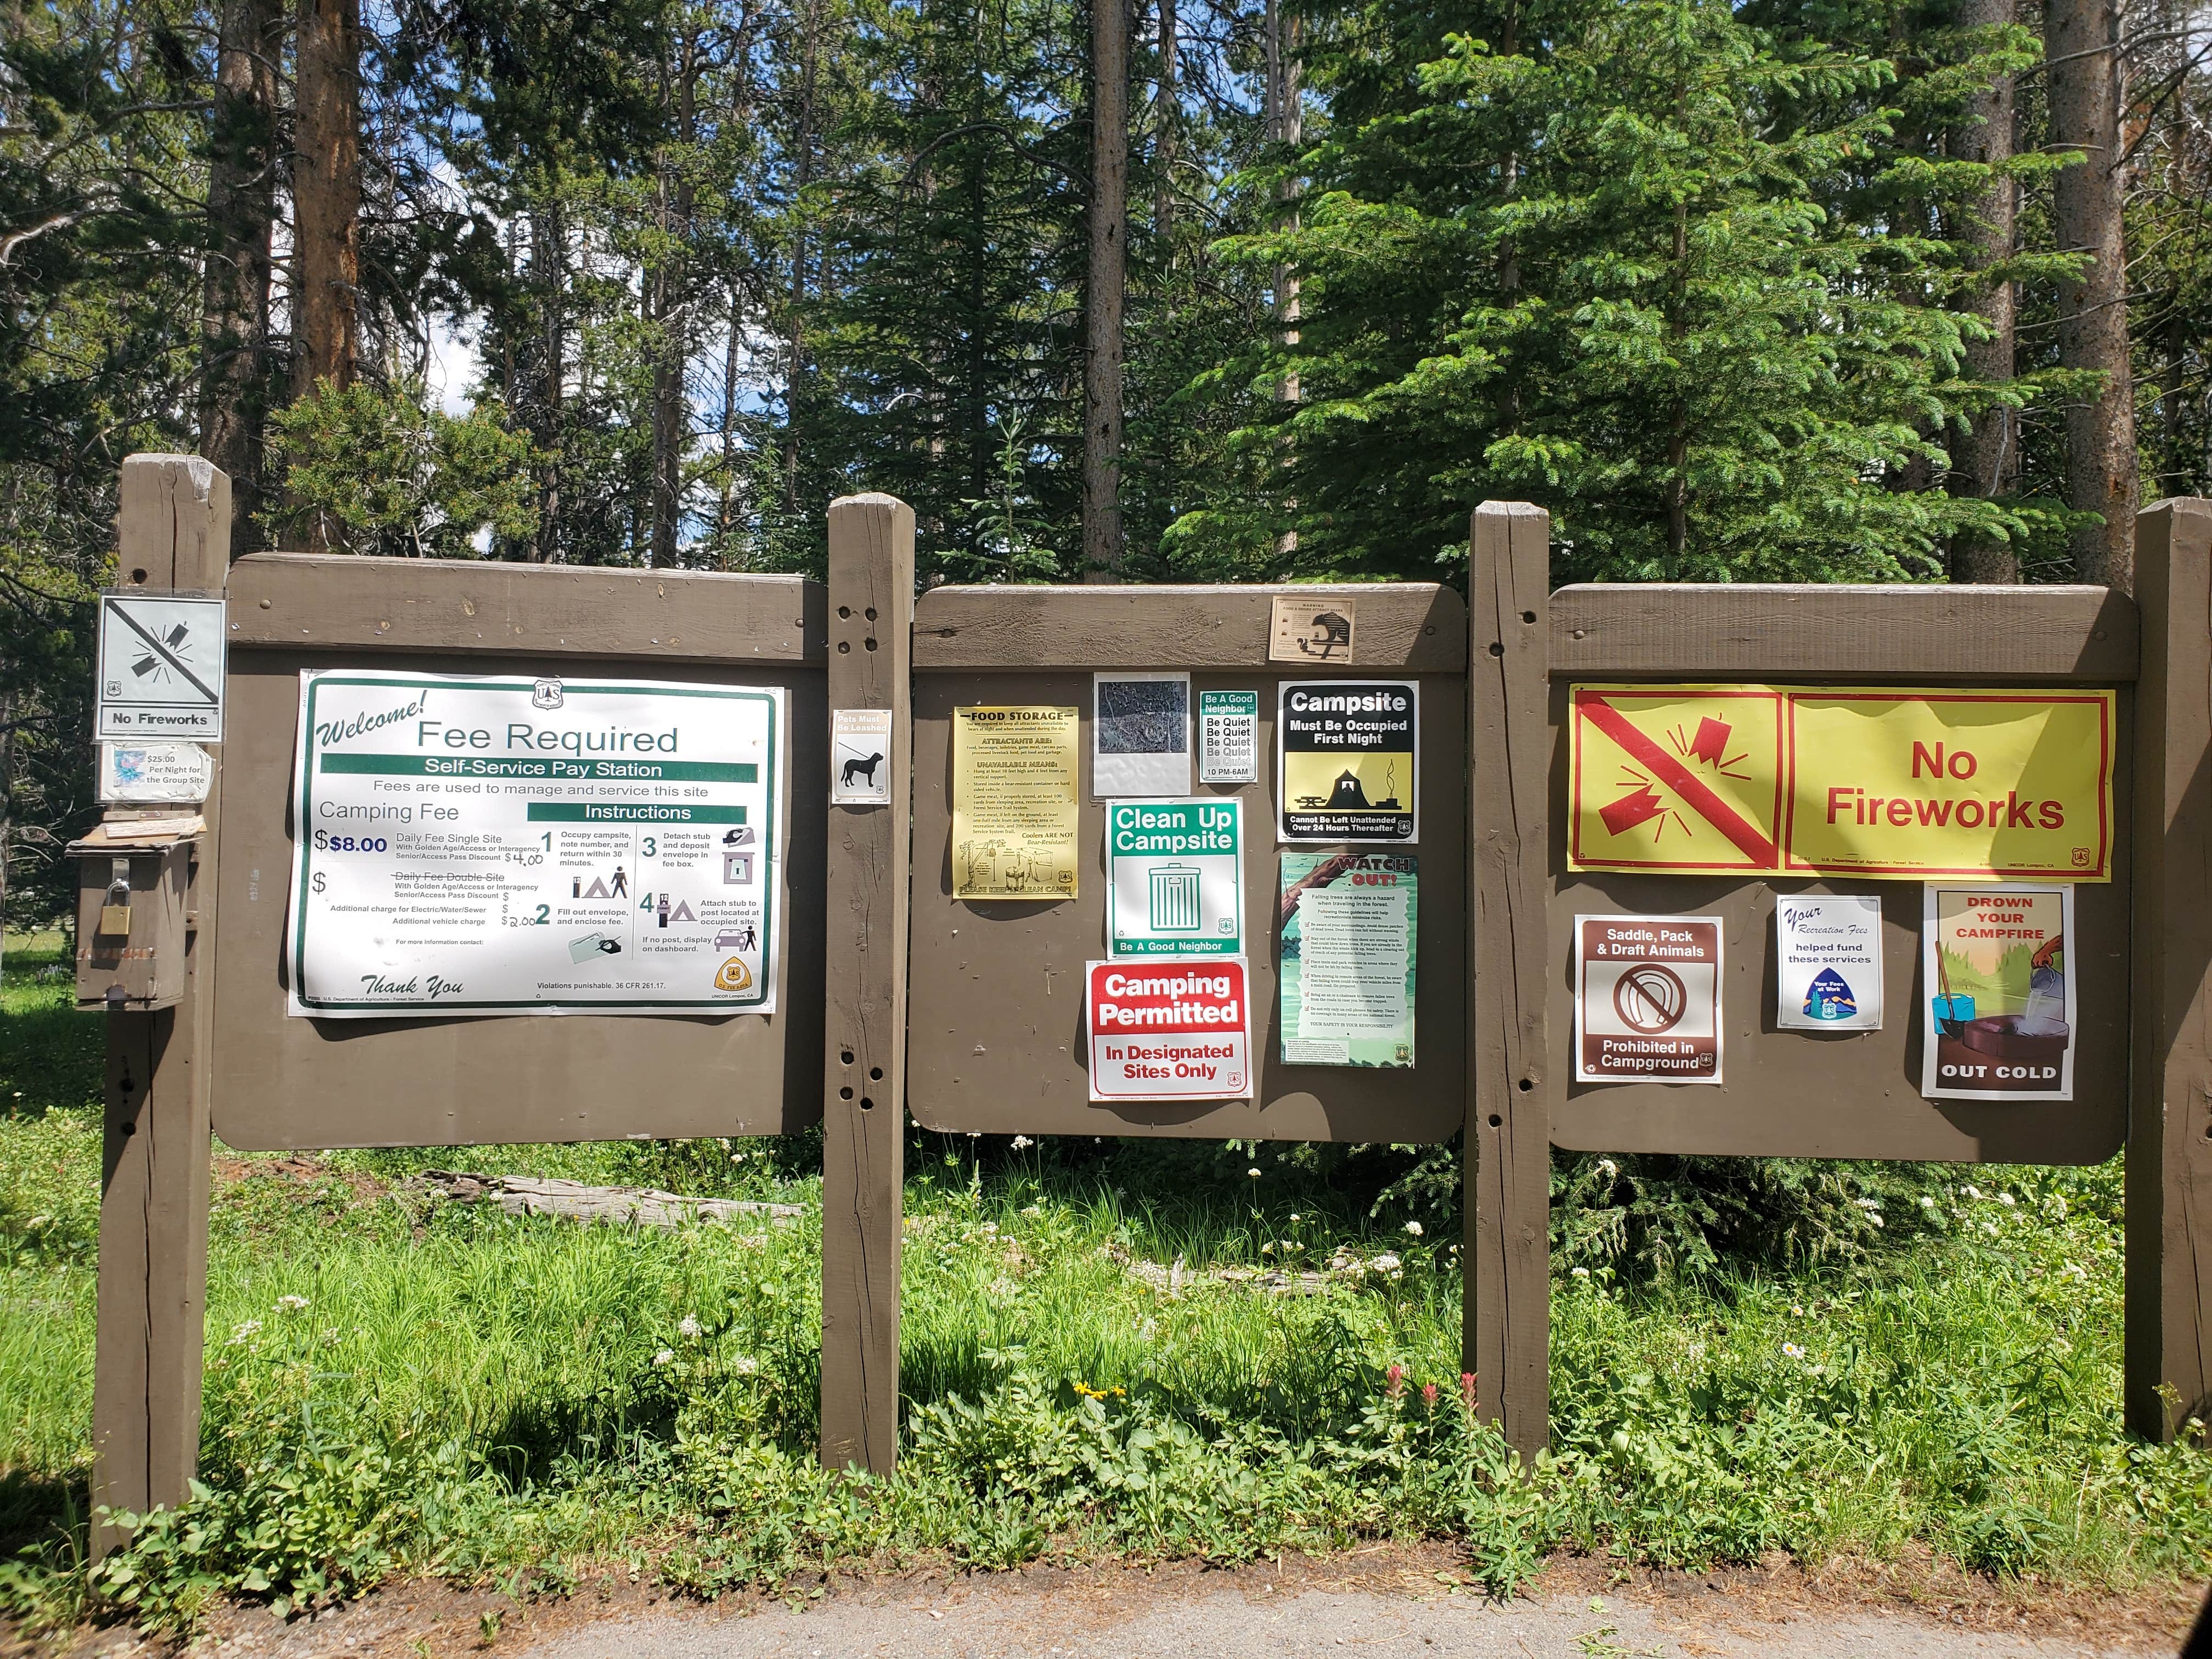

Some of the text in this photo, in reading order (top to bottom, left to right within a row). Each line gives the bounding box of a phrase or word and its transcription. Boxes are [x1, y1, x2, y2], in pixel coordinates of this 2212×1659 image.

[1229, 695, 1252, 703] Good
[1291, 692, 1407, 715] Campsite
[1205, 704, 1245, 714] Neighbor
[113, 713, 207, 725] No Fireworks
[316, 690, 427, 747] Welcome!
[1010, 712, 1063, 720] STORAGE
[1223, 718, 1251, 726] Quiet
[1223, 727, 1251, 736] Quiet
[1290, 720, 1407, 732] Must Be Occupied
[418, 721, 678, 757] Fee Required
[1223, 737, 1251, 746] Quiet
[1314, 733, 1382, 746] First Night
[1223, 747, 1251, 756] Quiet
[148, 755, 175, 763] $25.00
[1207, 757, 1251, 766] Be Quiet
[1911, 741, 1978, 781] No
[165, 766, 187, 774] Night
[425, 758, 662, 779] Self-Service Pay Station
[163, 776, 187, 785] Group
[374, 781, 708, 797] Fees are used to manage and service this site
[320, 802, 459, 823] Camping Fee
[586, 805, 691, 820] Instructions
[1827, 786, 2065, 830] Fireworks
[1116, 807, 1232, 832] Clean Up
[315, 828, 387, 853] $ $8.00
[396, 833, 501, 844] Daily Fee Single Site
[541, 832, 551, 851] 1
[561, 832, 631, 840] Occupy campsite,
[1116, 831, 1233, 853] Campsite
[505, 853, 511, 862] $
[514, 853, 543, 866] 4.00
[1337, 857, 1409, 871] WATCH
[1352, 873, 1397, 887] OUT!
[1967, 898, 2033, 907] DROWN
[1784, 907, 1822, 932] Your
[1977, 913, 2024, 923] YOUR
[1607, 928, 1692, 943] Saddle, Pack
[1798, 924, 1867, 935] Recreation Fees
[1956, 928, 2045, 939] CAMPFIRE
[1120, 942, 1222, 952] Be A Good Neighbor
[1597, 944, 1704, 957] & Draft Animals
[1796, 944, 1833, 952] helped
[360, 975, 464, 1000] Thank You
[1105, 972, 1230, 1000] Camping
[1099, 1000, 1238, 1026] Permitted
[1105, 1043, 1234, 1062] In Designated
[1603, 1040, 1694, 1054] Prohibited in
[1601, 1054, 1699, 1070] Campground
[1124, 1063, 1217, 1080] Sites Only
[1941, 1065, 2056, 1079] OUT COLD
